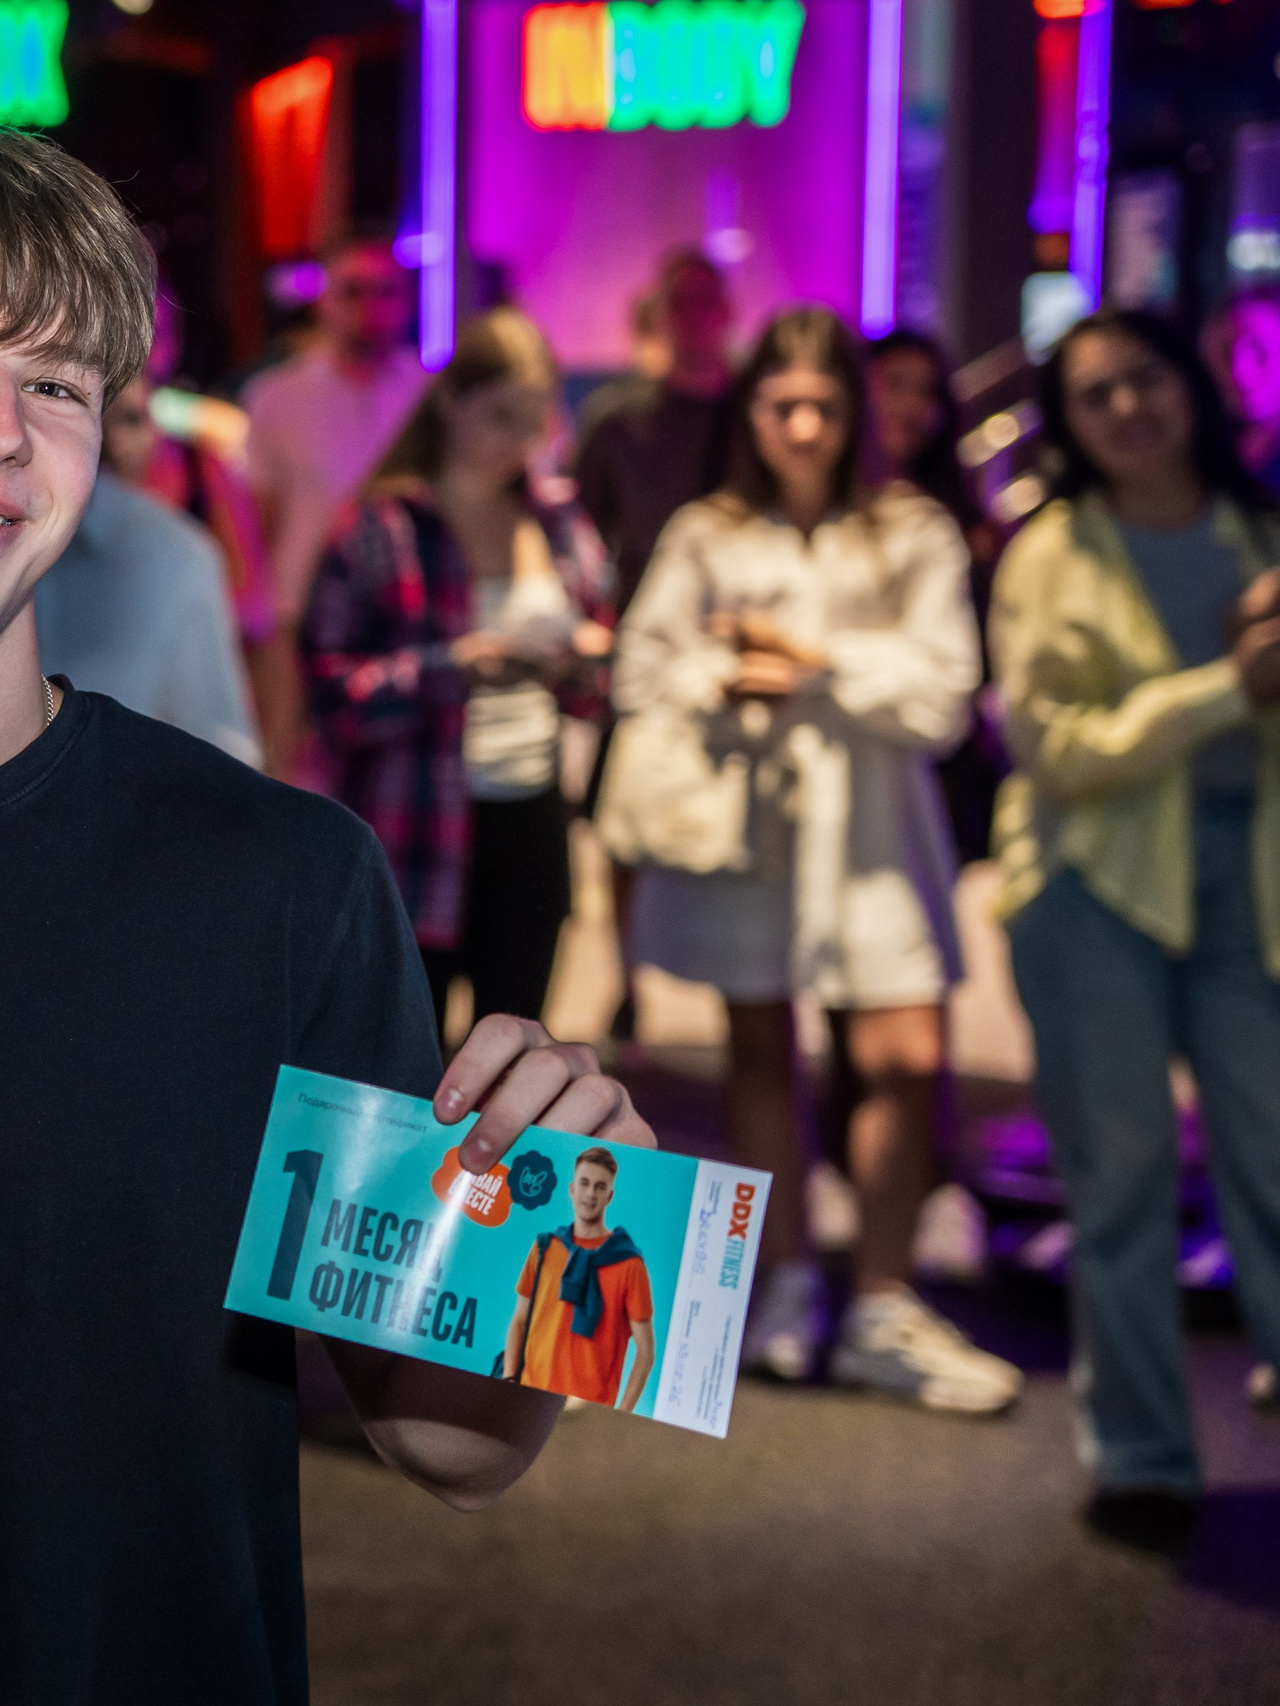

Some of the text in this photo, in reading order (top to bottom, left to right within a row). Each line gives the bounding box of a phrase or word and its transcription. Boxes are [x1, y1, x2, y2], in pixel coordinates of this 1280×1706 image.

[298, 1093, 365, 1117] Подарочны
[266, 1149, 324, 1301] 1
[727, 1182, 756, 1240] DDX
[718, 1238, 745, 1289] FITNESS
